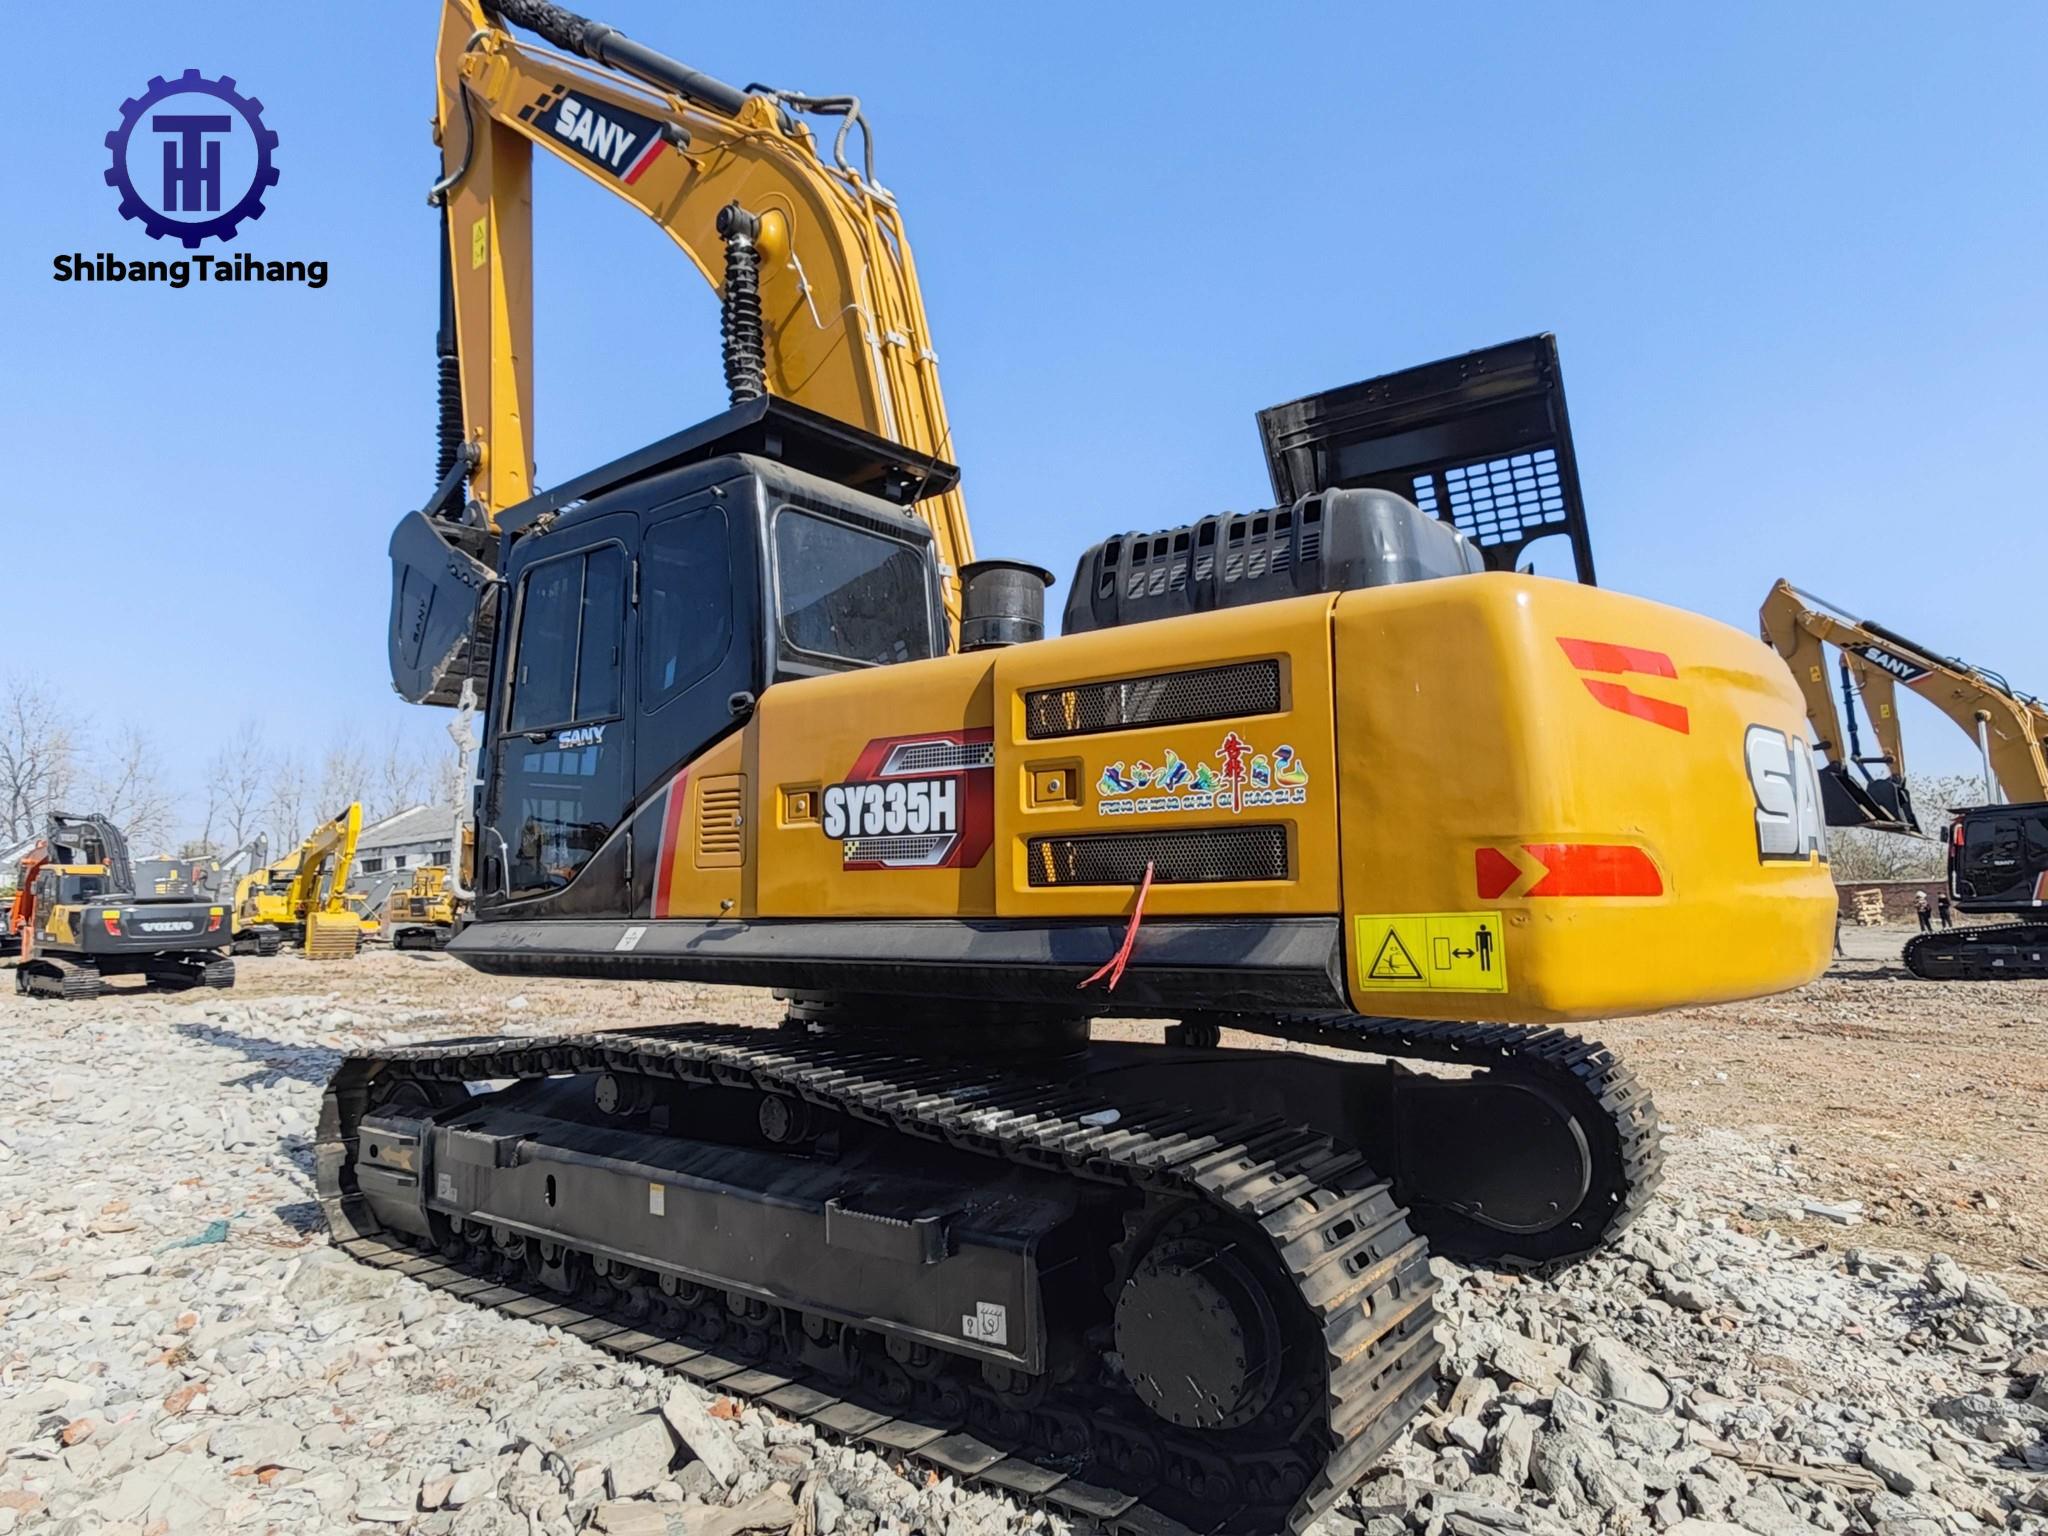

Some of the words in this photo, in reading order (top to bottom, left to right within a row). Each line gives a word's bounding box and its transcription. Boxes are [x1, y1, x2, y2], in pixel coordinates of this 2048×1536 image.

[554, 97, 637, 168] SANY
[1864, 647, 1916, 678] SANY
[559, 725, 606, 749] SANY
[824, 779, 956, 838] SY335H
[1744, 723, 1828, 863] SA
[139, 920, 194, 932] VOLVO
